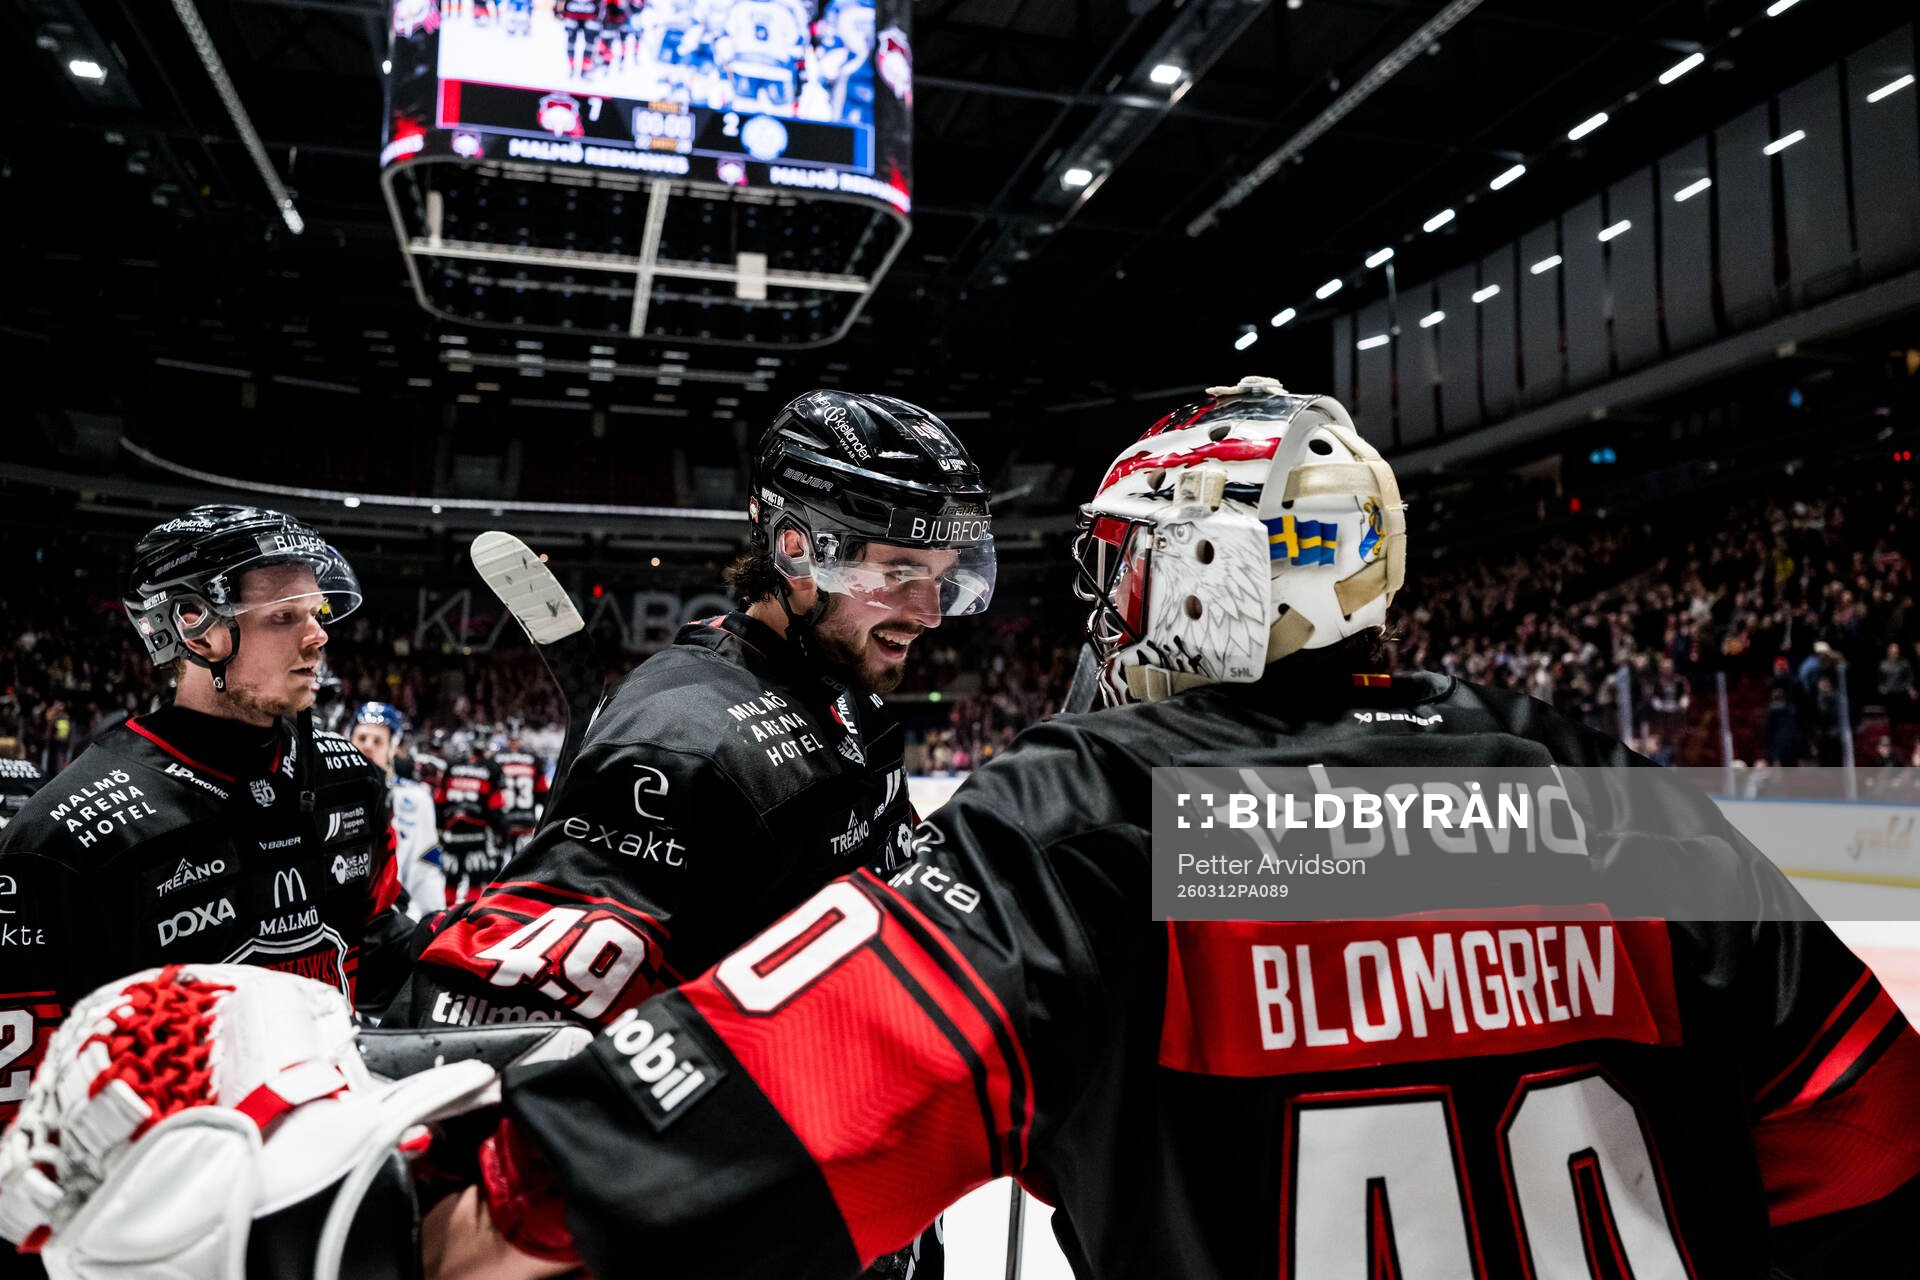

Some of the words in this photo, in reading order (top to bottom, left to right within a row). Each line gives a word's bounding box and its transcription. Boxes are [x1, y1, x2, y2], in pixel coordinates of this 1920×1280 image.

[587, 96, 602, 122] 7
[722, 112, 740, 137] 2
[1230, 666, 1253, 678] SHL
[751, 713, 806, 743] ARENA
[326, 754, 368, 770] HOTEL
[766, 734, 823, 767] HOTEL
[50, 769, 130, 821] MALMÖ
[66, 785, 145, 832] ARENA
[78, 801, 156, 848] HOTEL
[563, 817, 687, 870] exakt
[157, 898, 236, 947] DOXA
[259, 905, 319, 937] MALMÖ
[476, 906, 646, 1019] 49
[1252, 926, 1616, 1051] BLOMGREN
